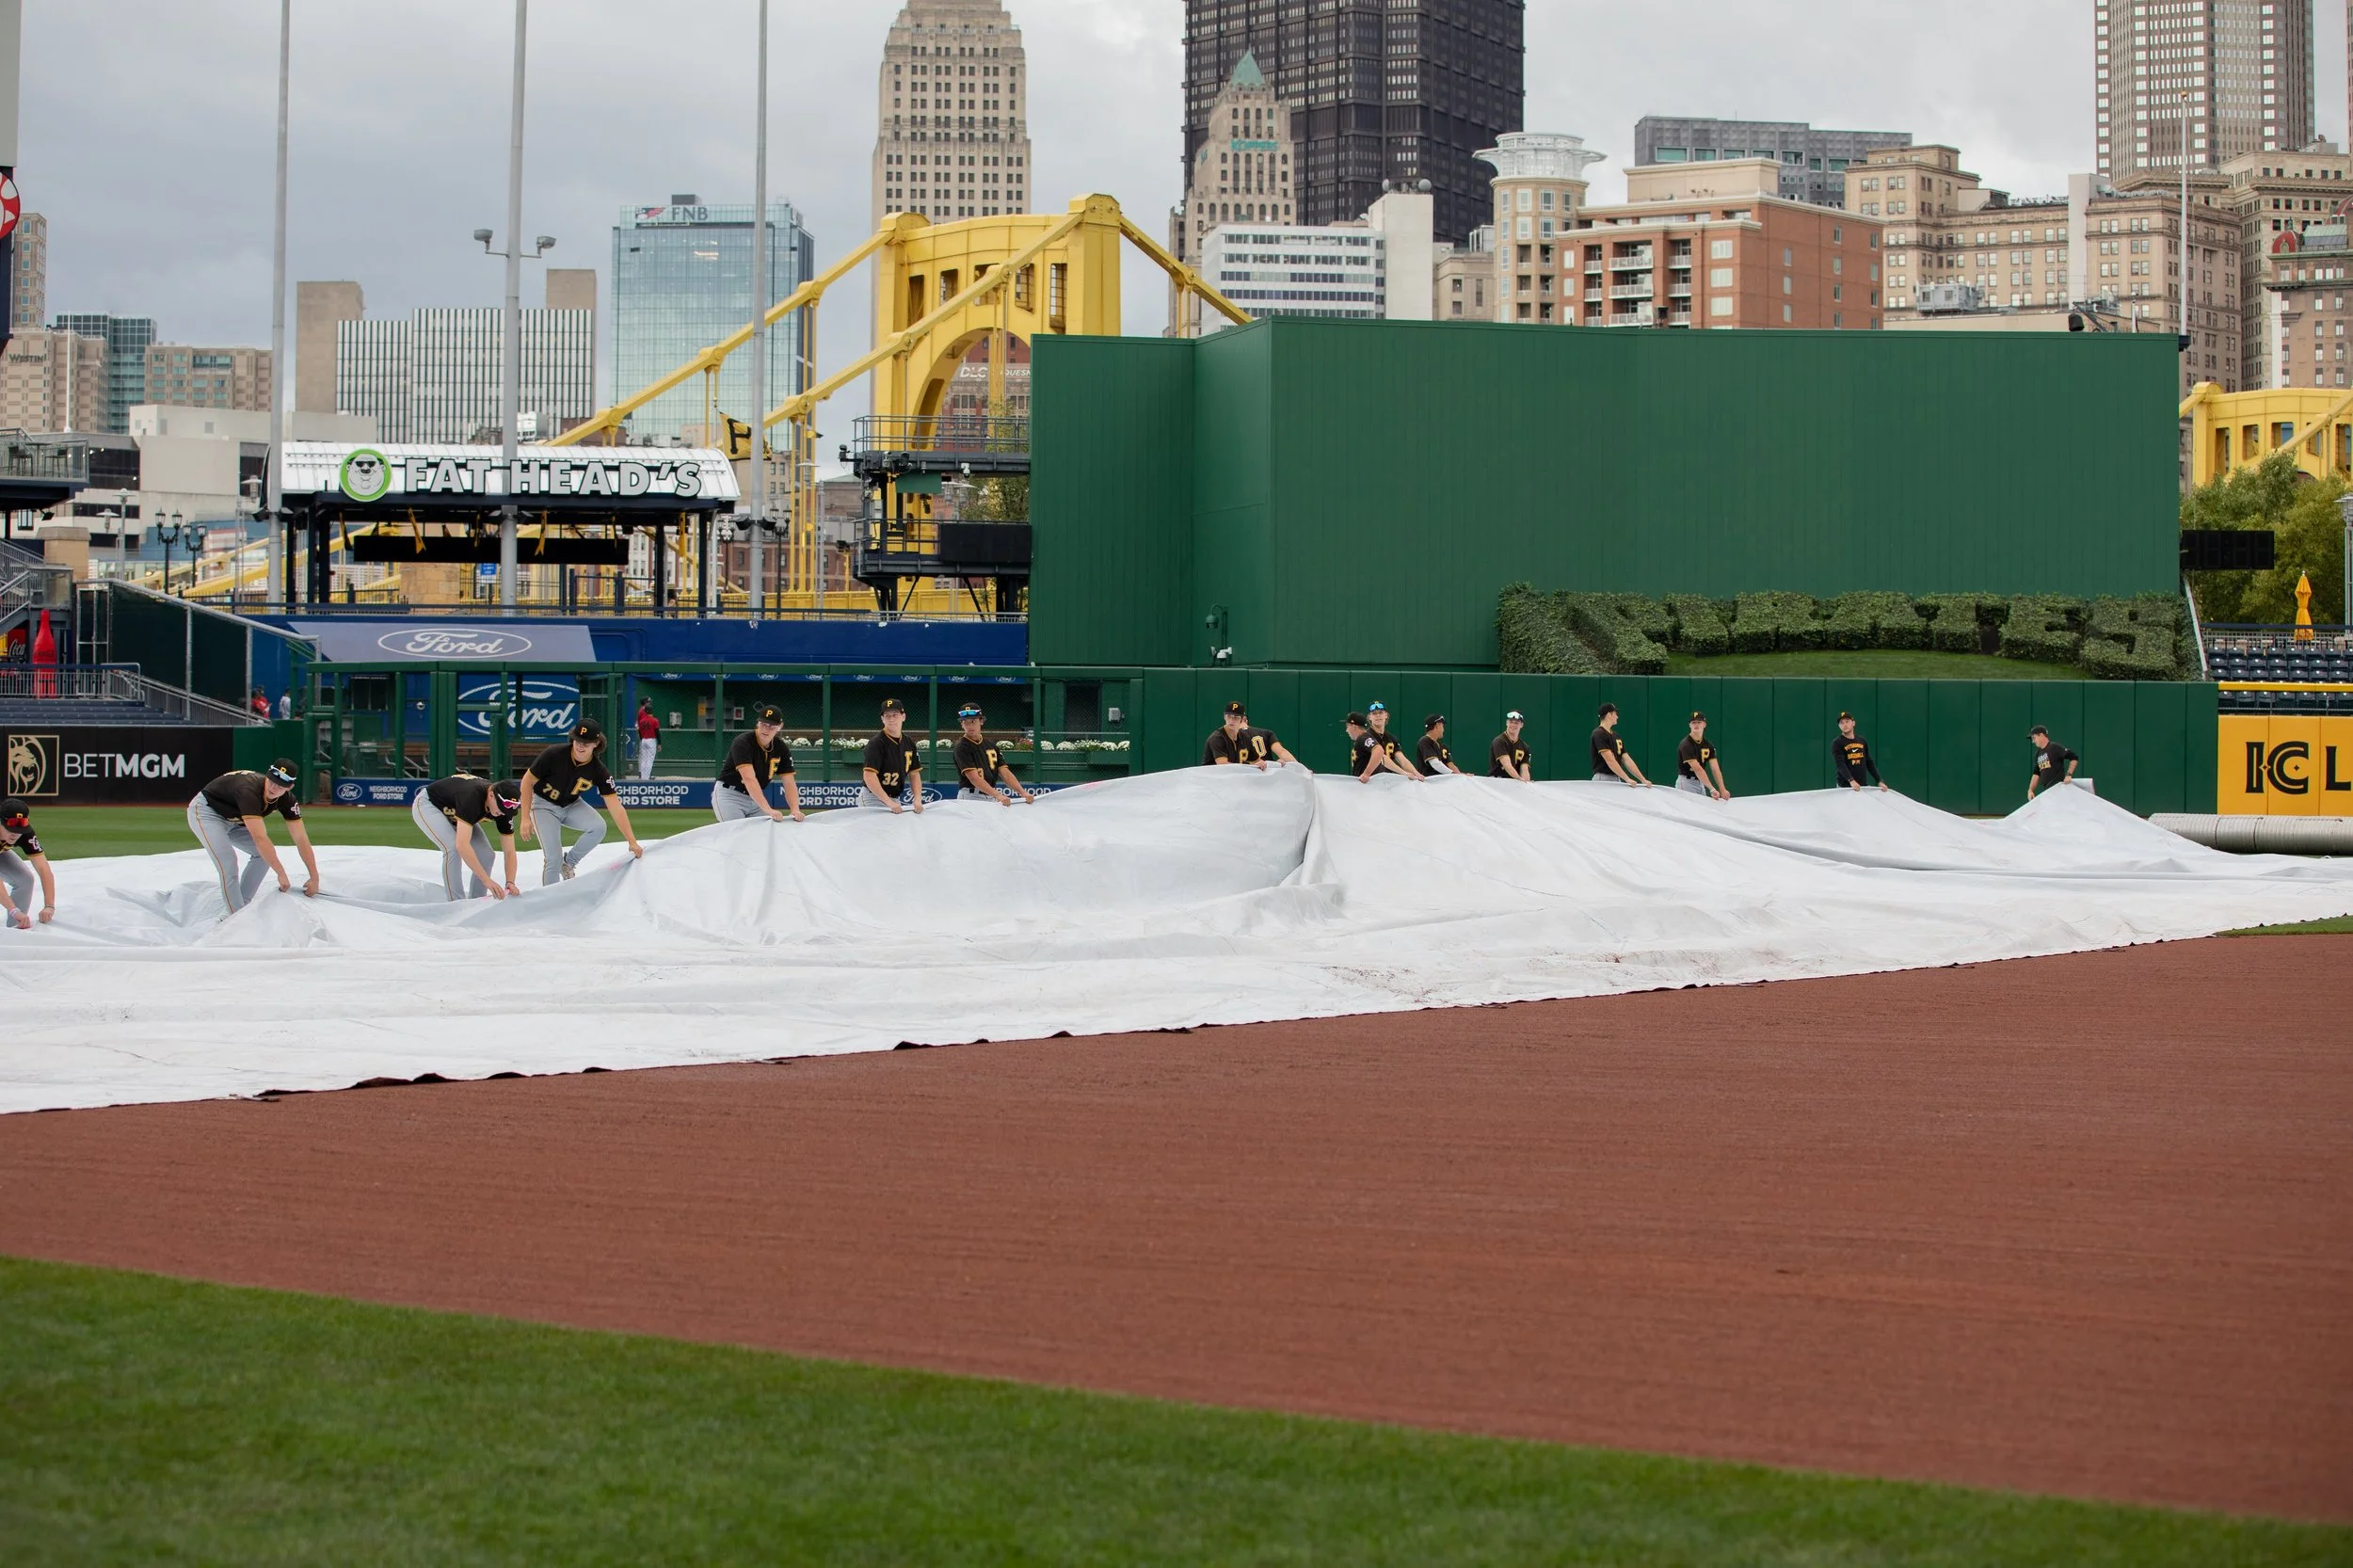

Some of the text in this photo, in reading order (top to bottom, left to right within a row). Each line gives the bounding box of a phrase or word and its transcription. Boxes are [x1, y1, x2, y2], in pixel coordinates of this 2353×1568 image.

[672, 207, 708, 221] FNB
[8, 354, 43, 362] WESTIN
[405, 457, 702, 498] FAT HEAD'S
[406, 632, 504, 654] Ford
[765, 709, 773, 717] P
[580, 727, 587, 735] P
[64, 754, 185, 778] BETMGM
[570, 776, 594, 796] P
[882, 772, 899, 787] 32
[341, 785, 359, 797] Ford
[369, 785, 408, 793] NEIGHBORHOOD
[542, 782, 561, 801] 78
[641, 795, 680, 805] STORE
[798, 796, 823, 806] ORD
